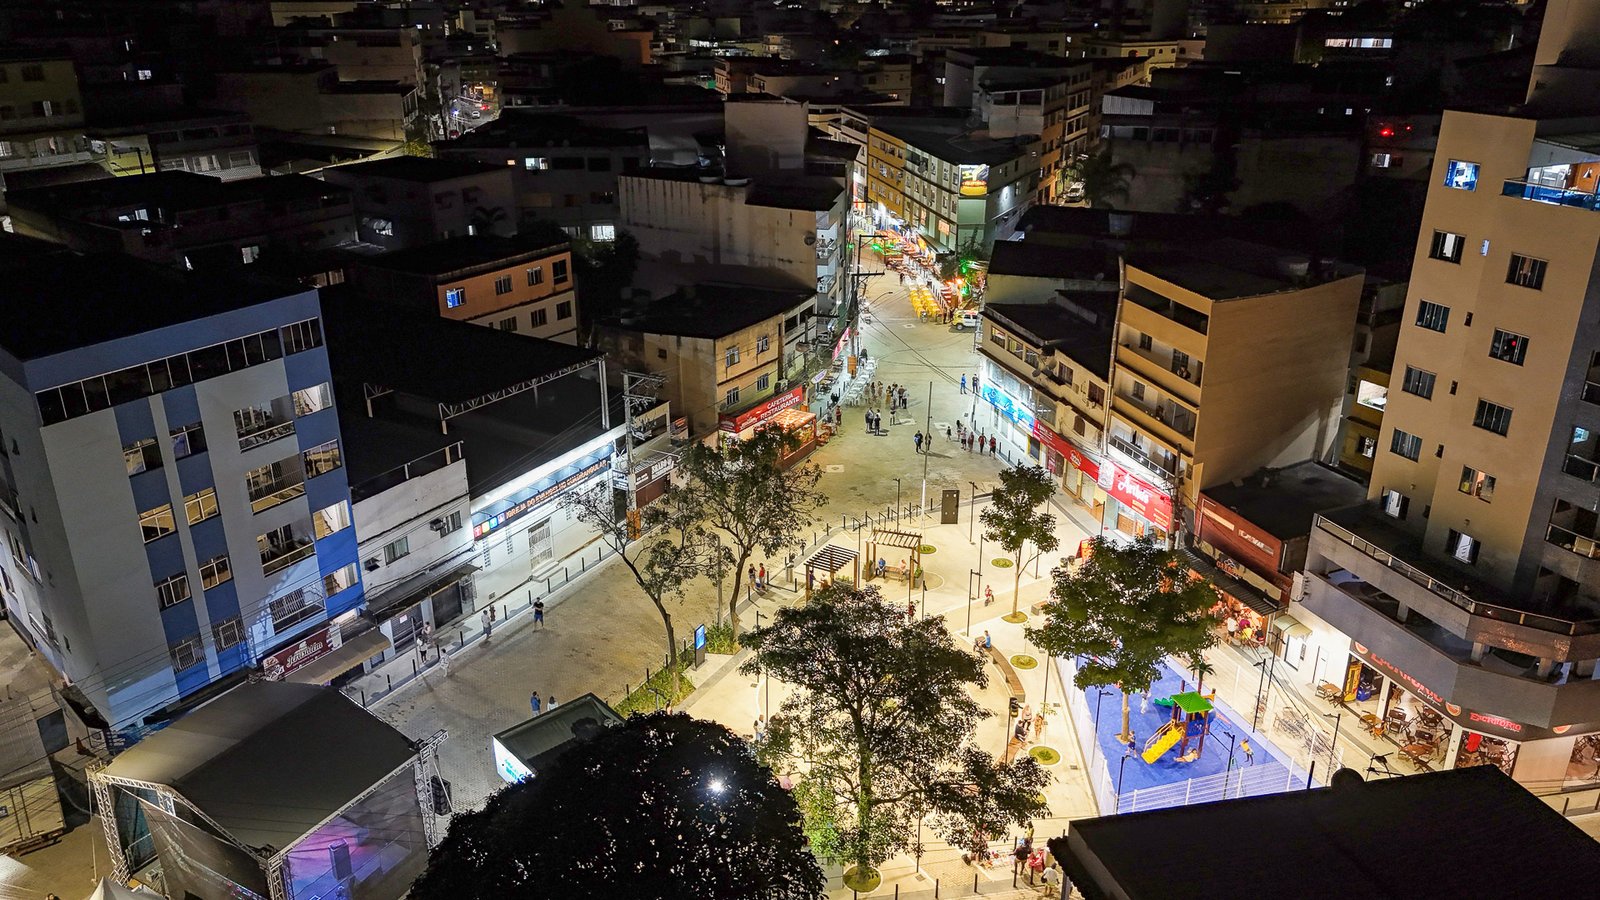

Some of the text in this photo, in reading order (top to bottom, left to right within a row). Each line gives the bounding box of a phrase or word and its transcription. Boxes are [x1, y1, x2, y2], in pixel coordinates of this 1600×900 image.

[760, 395, 800, 419] RESTAURANTE
[767, 393, 793, 409] CAFETERIA
[506, 503, 526, 519] IGREJA
[527, 497, 536, 508] DO
